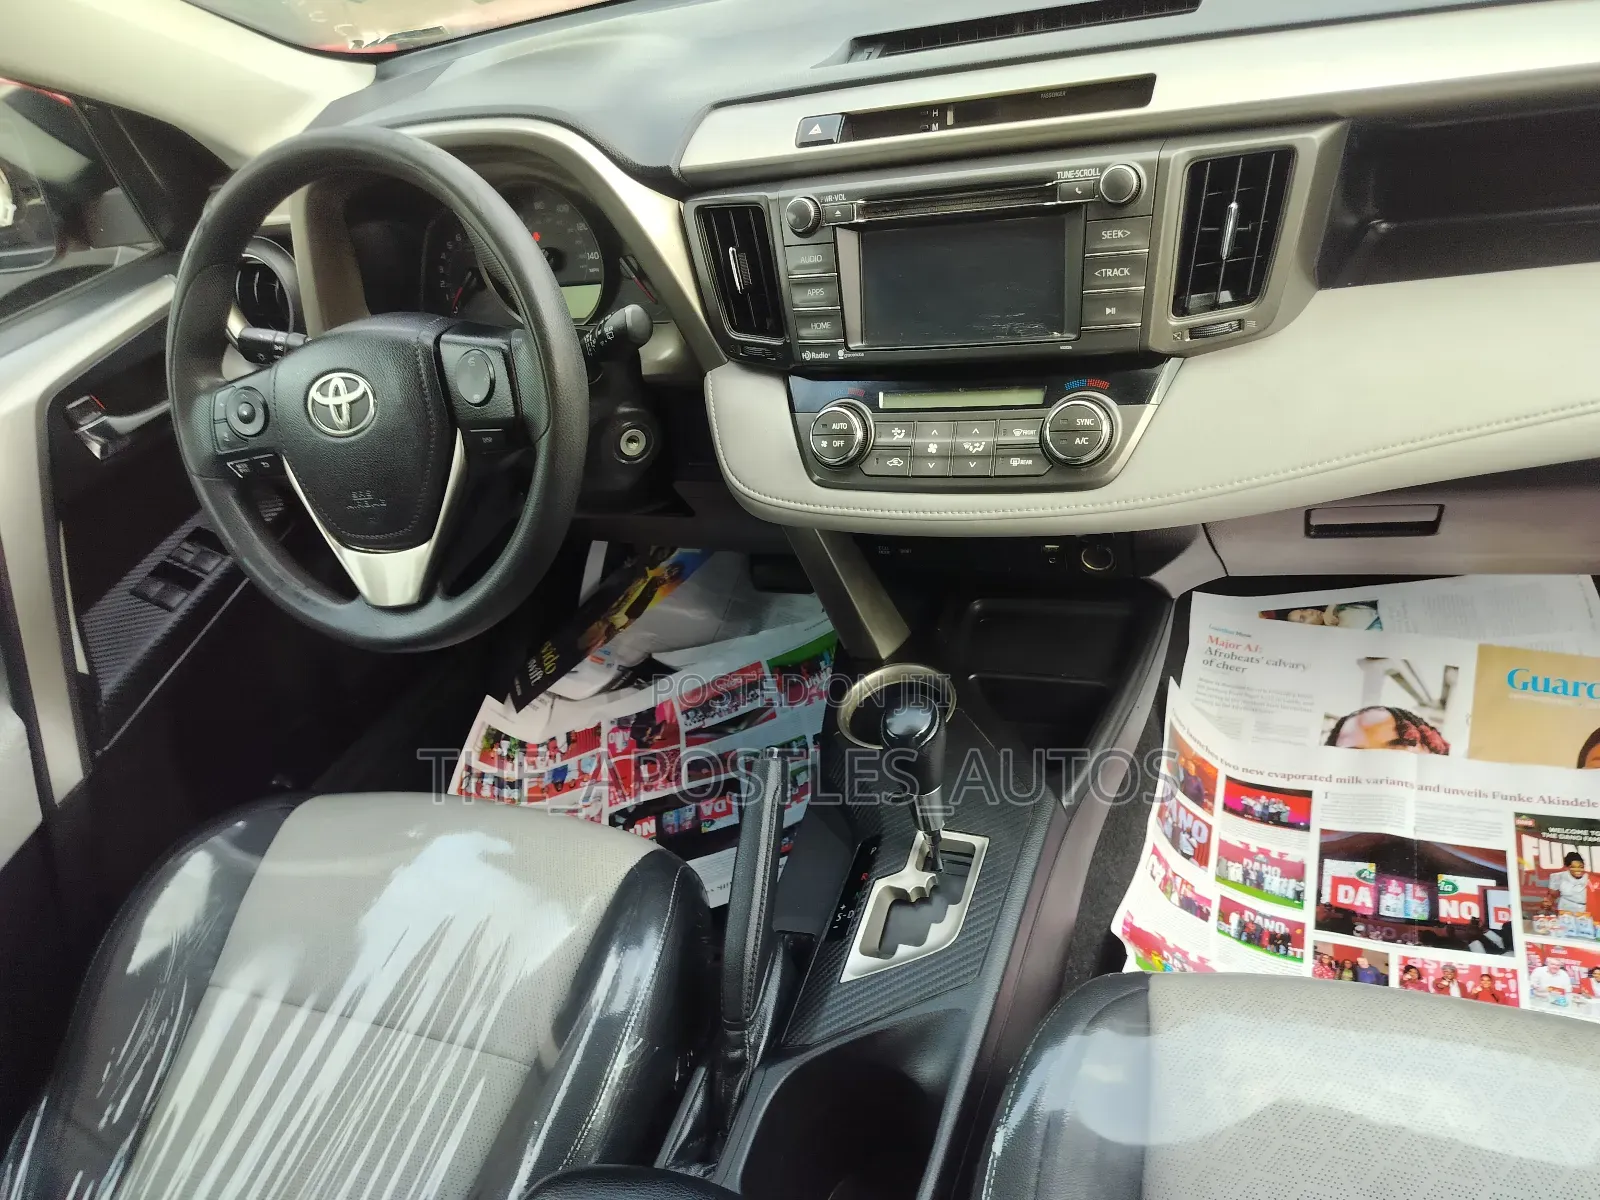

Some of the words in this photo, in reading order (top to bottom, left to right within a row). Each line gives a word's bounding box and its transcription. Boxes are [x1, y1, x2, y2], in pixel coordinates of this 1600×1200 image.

[932, 109, 939, 117] H
[932, 122, 939, 131] M
[587, 251, 600, 260] 140
[800, 254, 823, 264] AUDIO
[807, 288, 825, 297] APPS
[810, 321, 832, 331] HOME
[832, 422, 848, 430] AUTO
[1076, 418, 1095, 426] SYNC
[832, 440, 845, 448] OFF
[1074, 437, 1089, 445] A/C
[1206, 634, 1243, 651] Major
[1201, 657, 1215, 668] of
[1215, 660, 1249, 674] cheer
[1219, 756, 1240, 773] two
[1241, 767, 1265, 777] new
[1267, 770, 1333, 784] evaporated
[1335, 774, 1363, 785] milk
[1365, 777, 1415, 790] variants
[1417, 782, 1441, 794] and
[1443, 786, 1489, 799] unveils
[1491, 790, 1533, 804] Funke
[1537, 795, 1599, 809] Akindele
[1547, 827, 1590, 836] WELCOME
